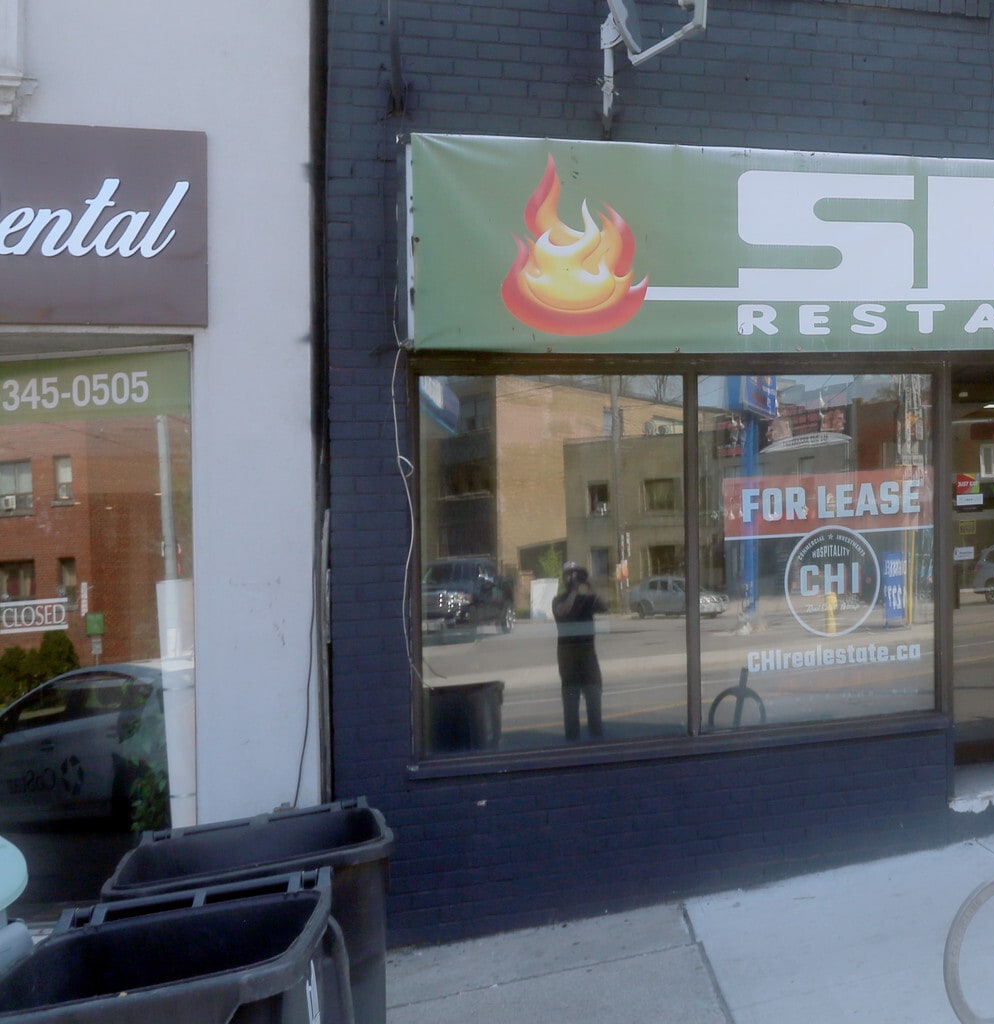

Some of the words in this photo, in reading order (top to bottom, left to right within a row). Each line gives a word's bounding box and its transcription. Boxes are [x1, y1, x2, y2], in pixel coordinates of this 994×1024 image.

[2, 371, 149, 411] 345-0505
[741, 486, 808, 523] FOR
[817, 479, 921, 520] LEASE
[811, 544, 850, 559] HOSPITALITY
[800, 562, 860, 597] CHI
[2, 603, 66, 628] CLOSED
[747, 643, 921, 673] CHIrealestate.ca
